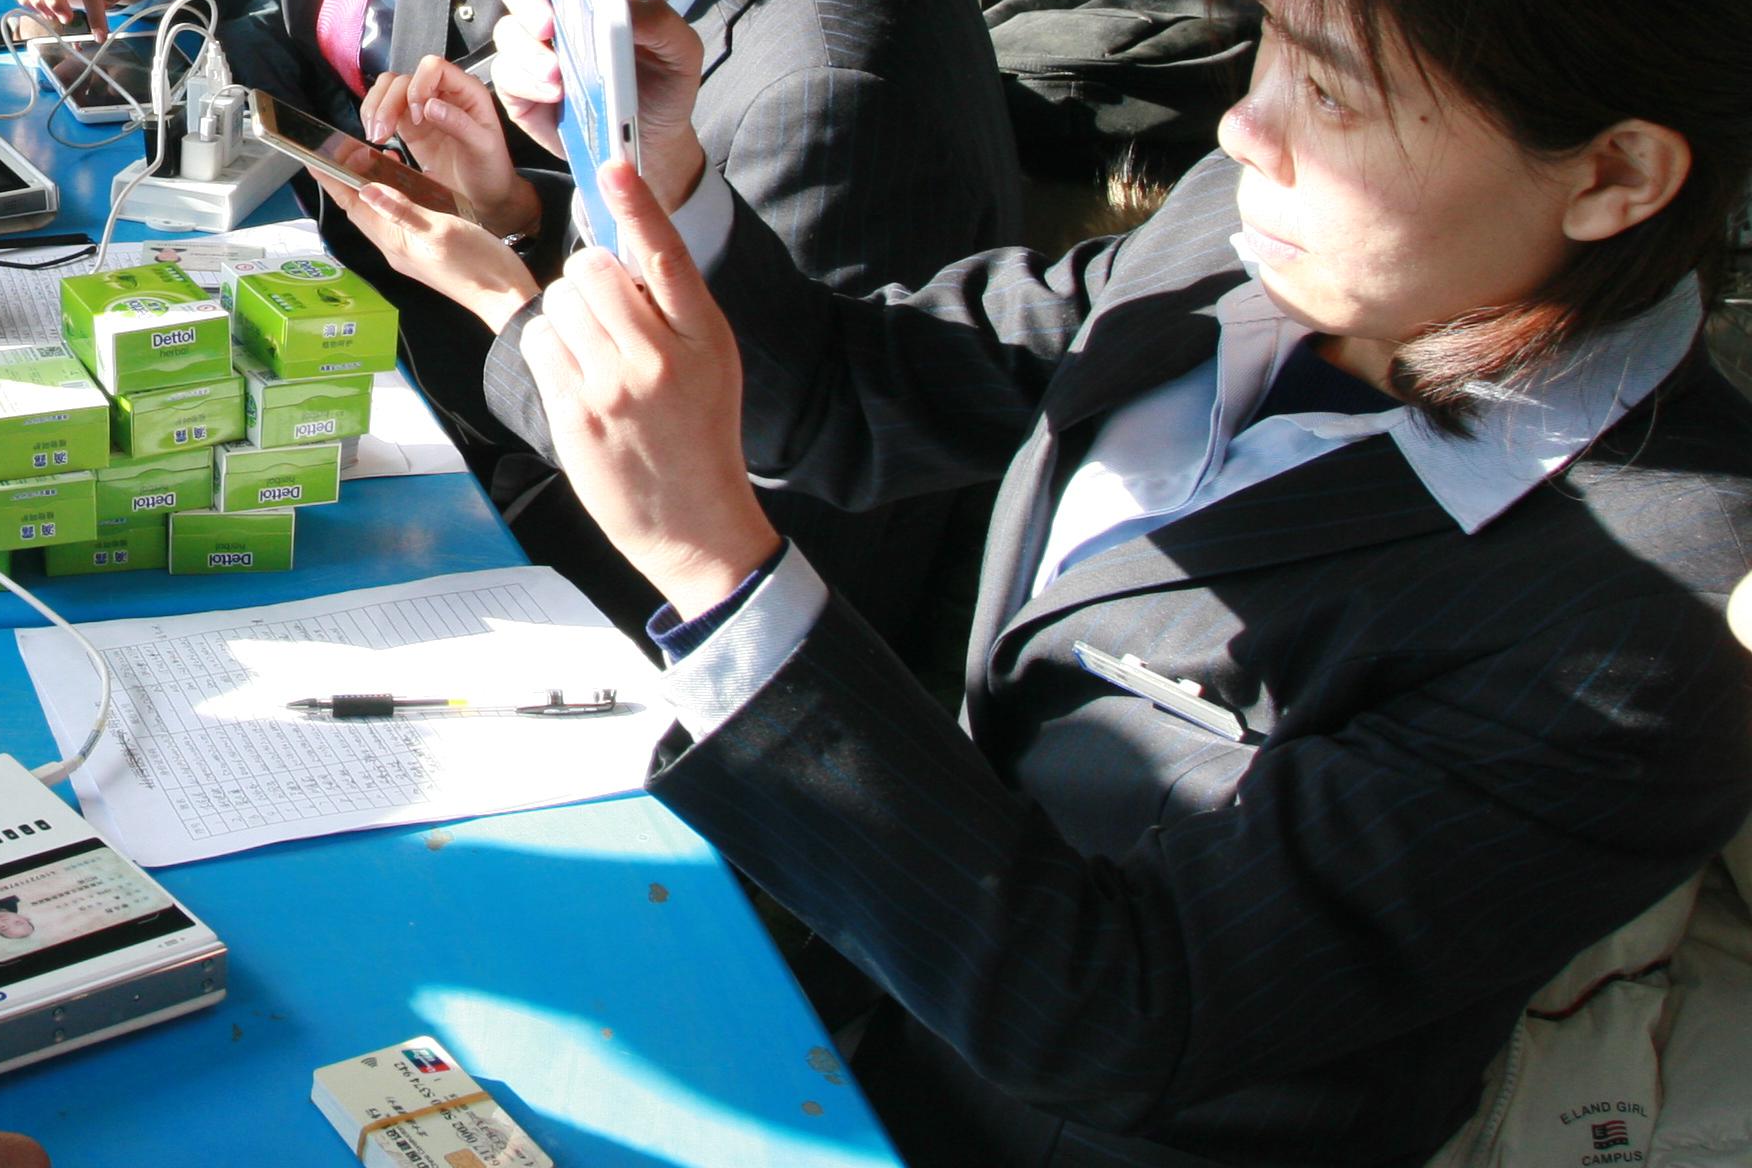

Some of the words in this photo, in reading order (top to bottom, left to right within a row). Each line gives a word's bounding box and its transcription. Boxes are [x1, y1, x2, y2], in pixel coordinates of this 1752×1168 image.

[153, 329, 196, 347] Dettol
[295, 420, 335, 439] Dettol
[34, 451, 68, 468] 滴露
[134, 494, 176, 511] Dettol
[260, 486, 301, 502] Dettol
[20, 523, 56, 539] 滴露
[94, 550, 128, 565] 滴露
[209, 553, 253, 567] Dettol
[394, 1062, 413, 1077] 942
[410, 1077, 436, 1099] 5374
[430, 1098, 452, 1121] 500
[1616, 1101, 1648, 1118] GIRL
[366, 1107, 431, 1168] 中国建设行
[1581, 1151, 1643, 1167] CAMPUS
